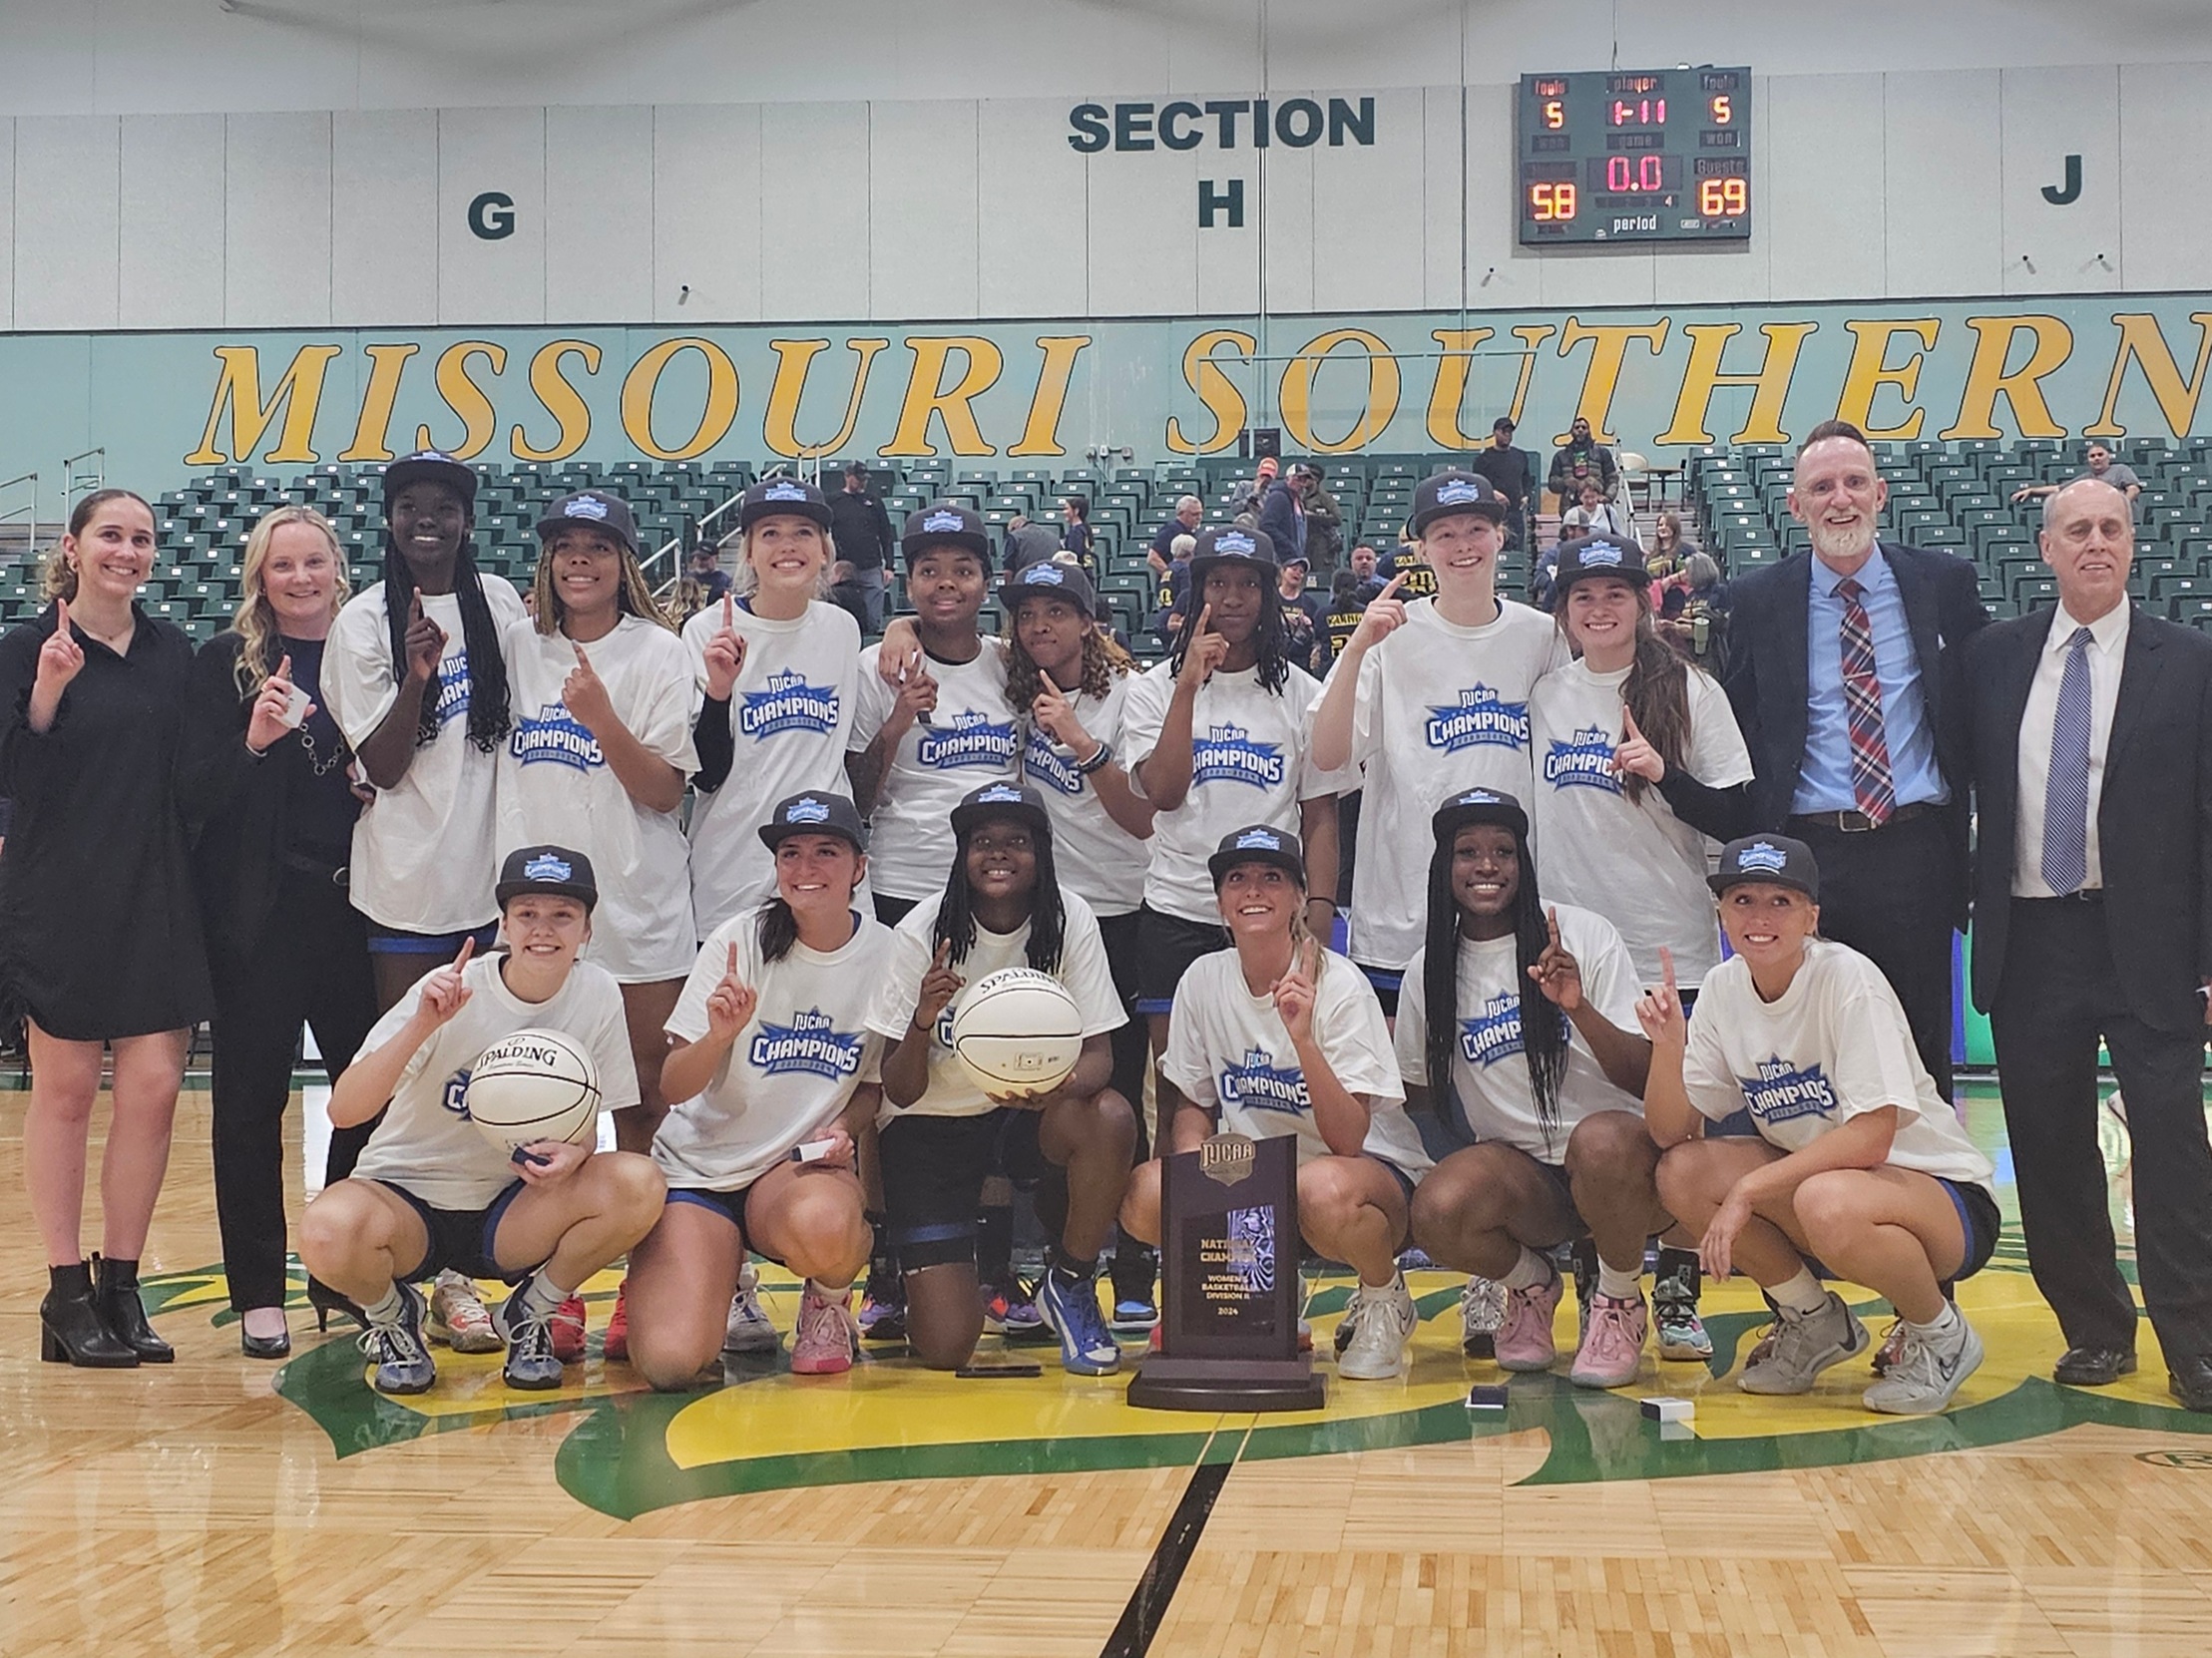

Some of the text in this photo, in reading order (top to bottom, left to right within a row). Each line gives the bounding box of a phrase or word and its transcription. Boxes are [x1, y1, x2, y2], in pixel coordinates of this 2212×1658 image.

[1068, 97, 1375, 153] SECTION
[1547, 101, 1563, 128] 5
[1713, 96, 1731, 124] 5
[1607, 155, 1662, 192] 0.0
[2040, 155, 2082, 206] J
[468, 187, 515, 240] G
[1198, 179, 1244, 228] H
[1532, 183, 1576, 220] 58
[1700, 178, 1747, 215] 69
[1613, 214, 1657, 233] period
[184, 312, 2212, 465] MISSOURI SOUTHERN
[742, 697, 838, 731] CHAMPIONS
[1429, 711, 1529, 745] CHAMPIONS
[513, 729, 604, 763] CHAMPIONS
[922, 734, 1017, 762] CHAMPIONS
[1192, 748, 1281, 781] HAMPIONS
[752, 1037, 860, 1072] CHAMPIONS
[1462, 1021, 1522, 1059] CHAMP
[477, 1046, 558, 1071] SPALDING
[1744, 1080, 1834, 1115] CHAMPIOS
[1202, 1143, 1252, 1167] NJCAA
[1217, 1306, 1239, 1316] 2024
